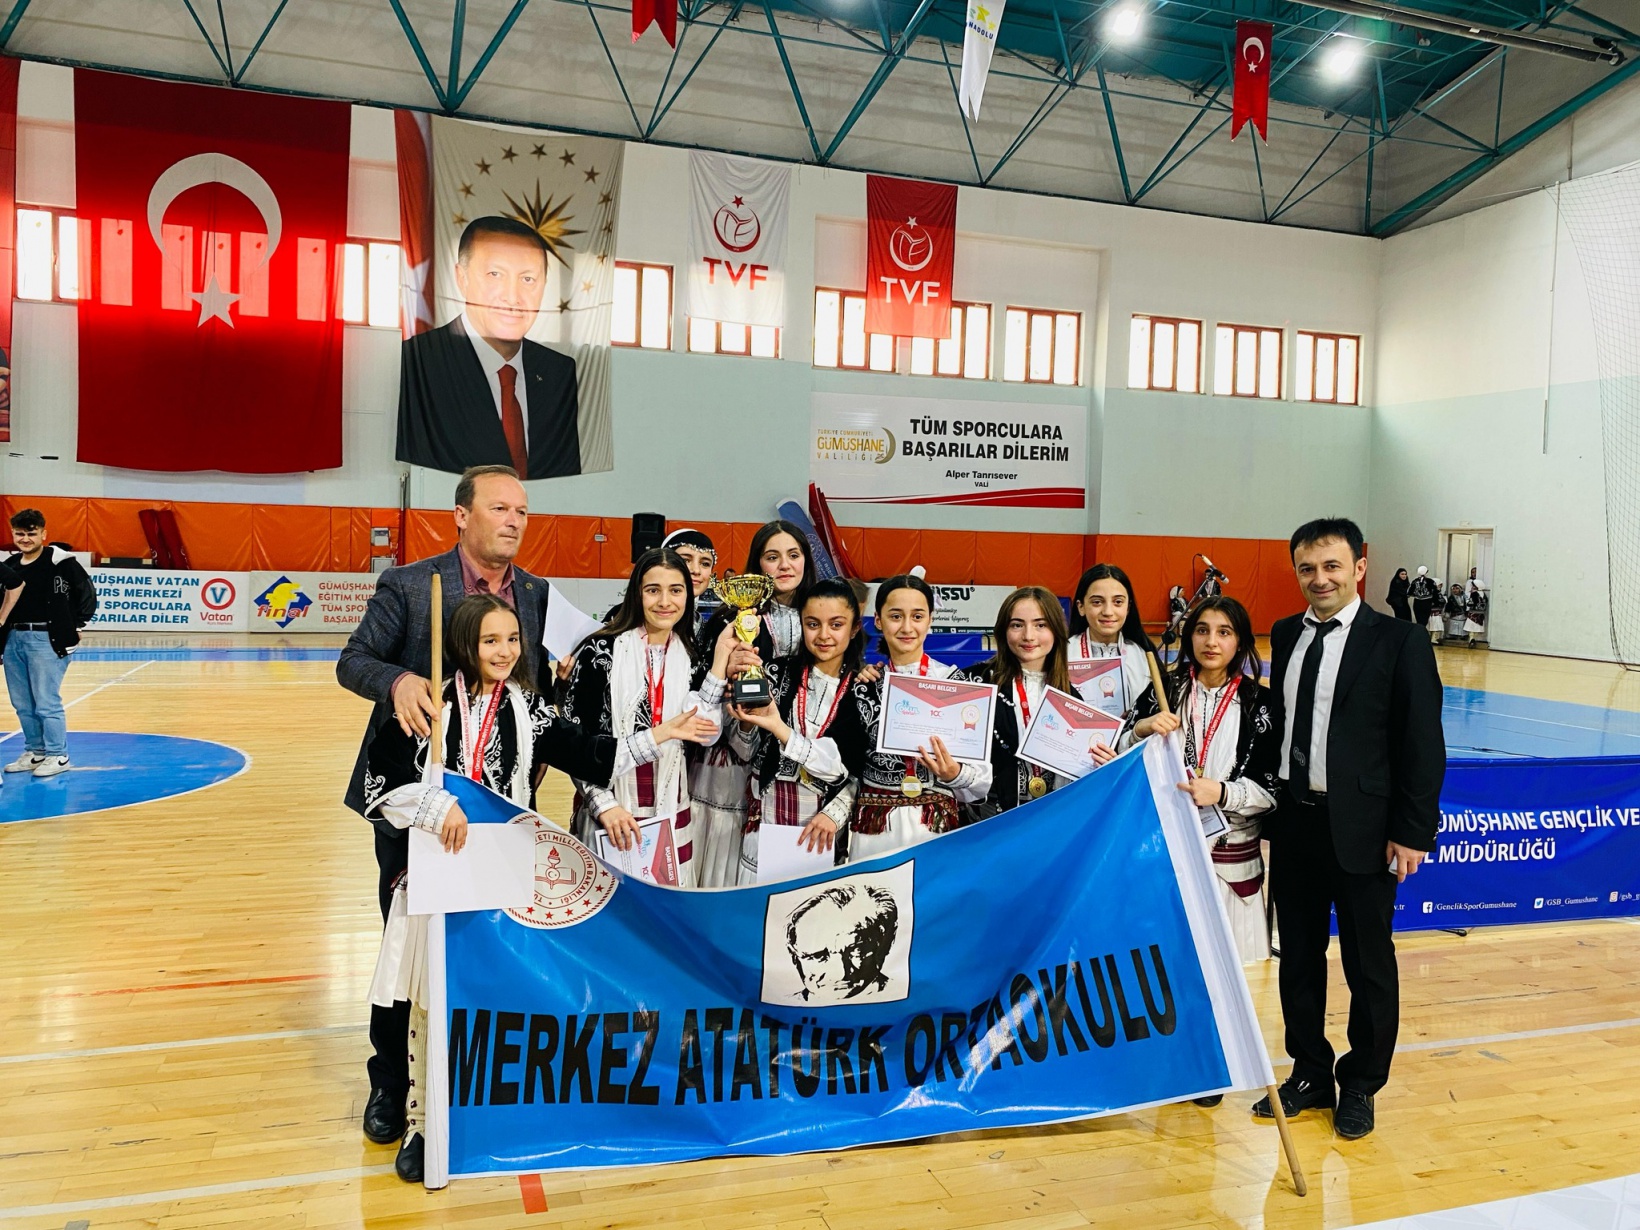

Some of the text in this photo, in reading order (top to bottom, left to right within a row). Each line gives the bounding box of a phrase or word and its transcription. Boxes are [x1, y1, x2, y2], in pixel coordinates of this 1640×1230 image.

[966, 21, 994, 40] NADOLU
[703, 256, 769, 290] TVF
[880, 276, 941, 306] TVF
[910, 416, 1063, 441] TÜM SPORCULARA
[817, 436, 885, 454] GÜMÜŞHANE
[902, 441, 1069, 462] BAŞARILAR DİLERİM
[945, 470, 1018, 480] Alper Tanrısever
[156, 577, 200, 587] VATAN
[124, 587, 182, 599] MERKEZİ
[318, 592, 352, 601] EĞİTİM
[104, 601, 192, 611] SPORCULARA
[257, 604, 309, 619] final
[321, 603, 342, 612] TÜM
[151, 613, 189, 624] DİLER
[200, 611, 233, 622] Vatan
[1540, 805, 1615, 833] GENÇLİK
[1616, 808, 1640, 826] VE
[1438, 838, 1556, 863] MÜDÜRLÜĞÜ
[449, 944, 1177, 1107] MERKEZ ATATÜRK ORTAOKULU
